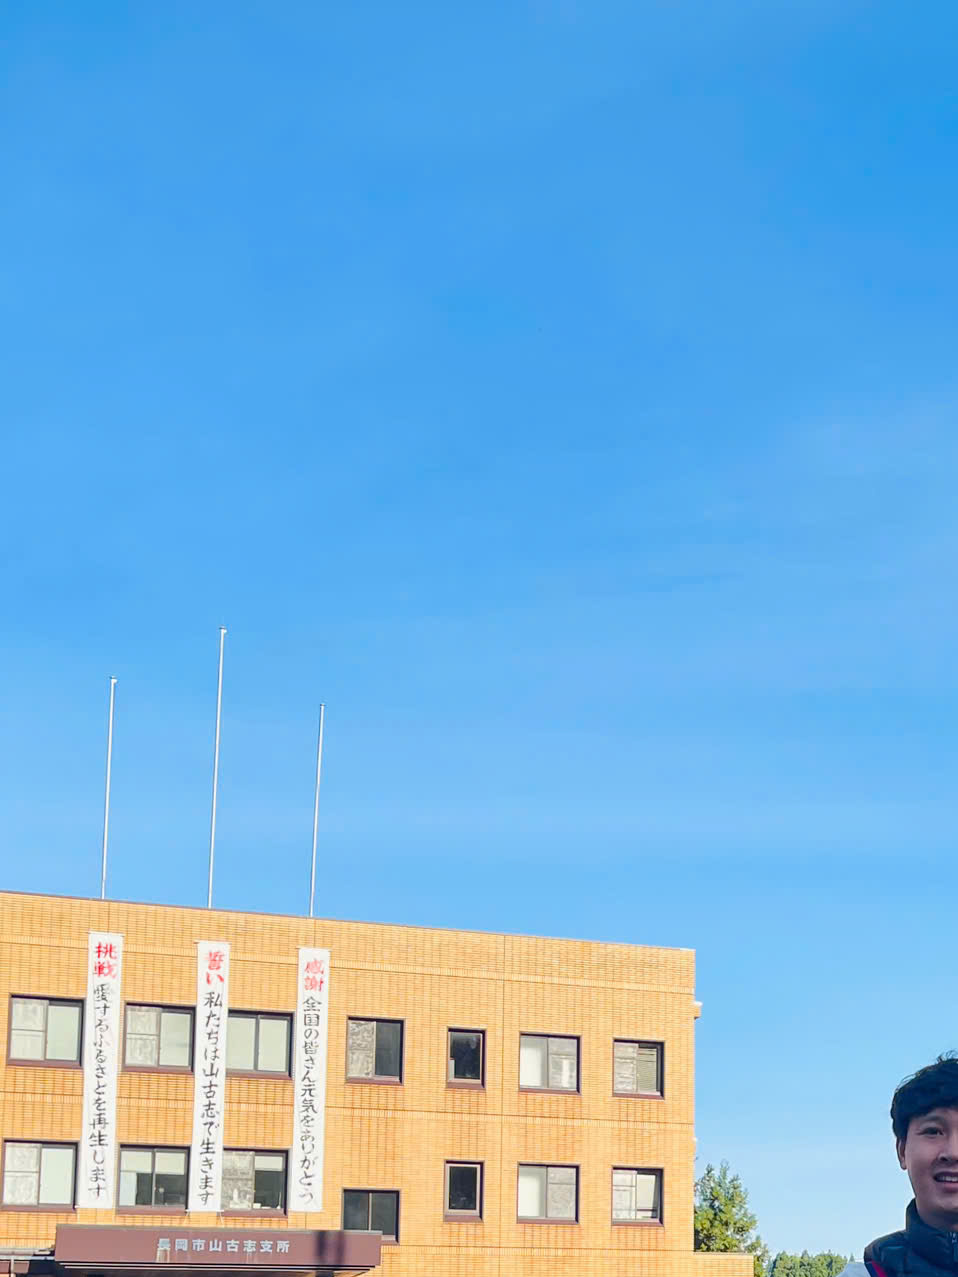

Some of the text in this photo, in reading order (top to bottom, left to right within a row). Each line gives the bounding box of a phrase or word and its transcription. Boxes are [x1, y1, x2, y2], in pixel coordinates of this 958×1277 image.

[93, 941, 117, 979] 挑戦
[199, 951, 225, 1206] 誓い 私たちは山古志で生きます
[299, 958, 324, 1204] 感謝 全国の皆さん元気をありがとう
[157, 1238, 290, 1253] 長岡市山古志支所
